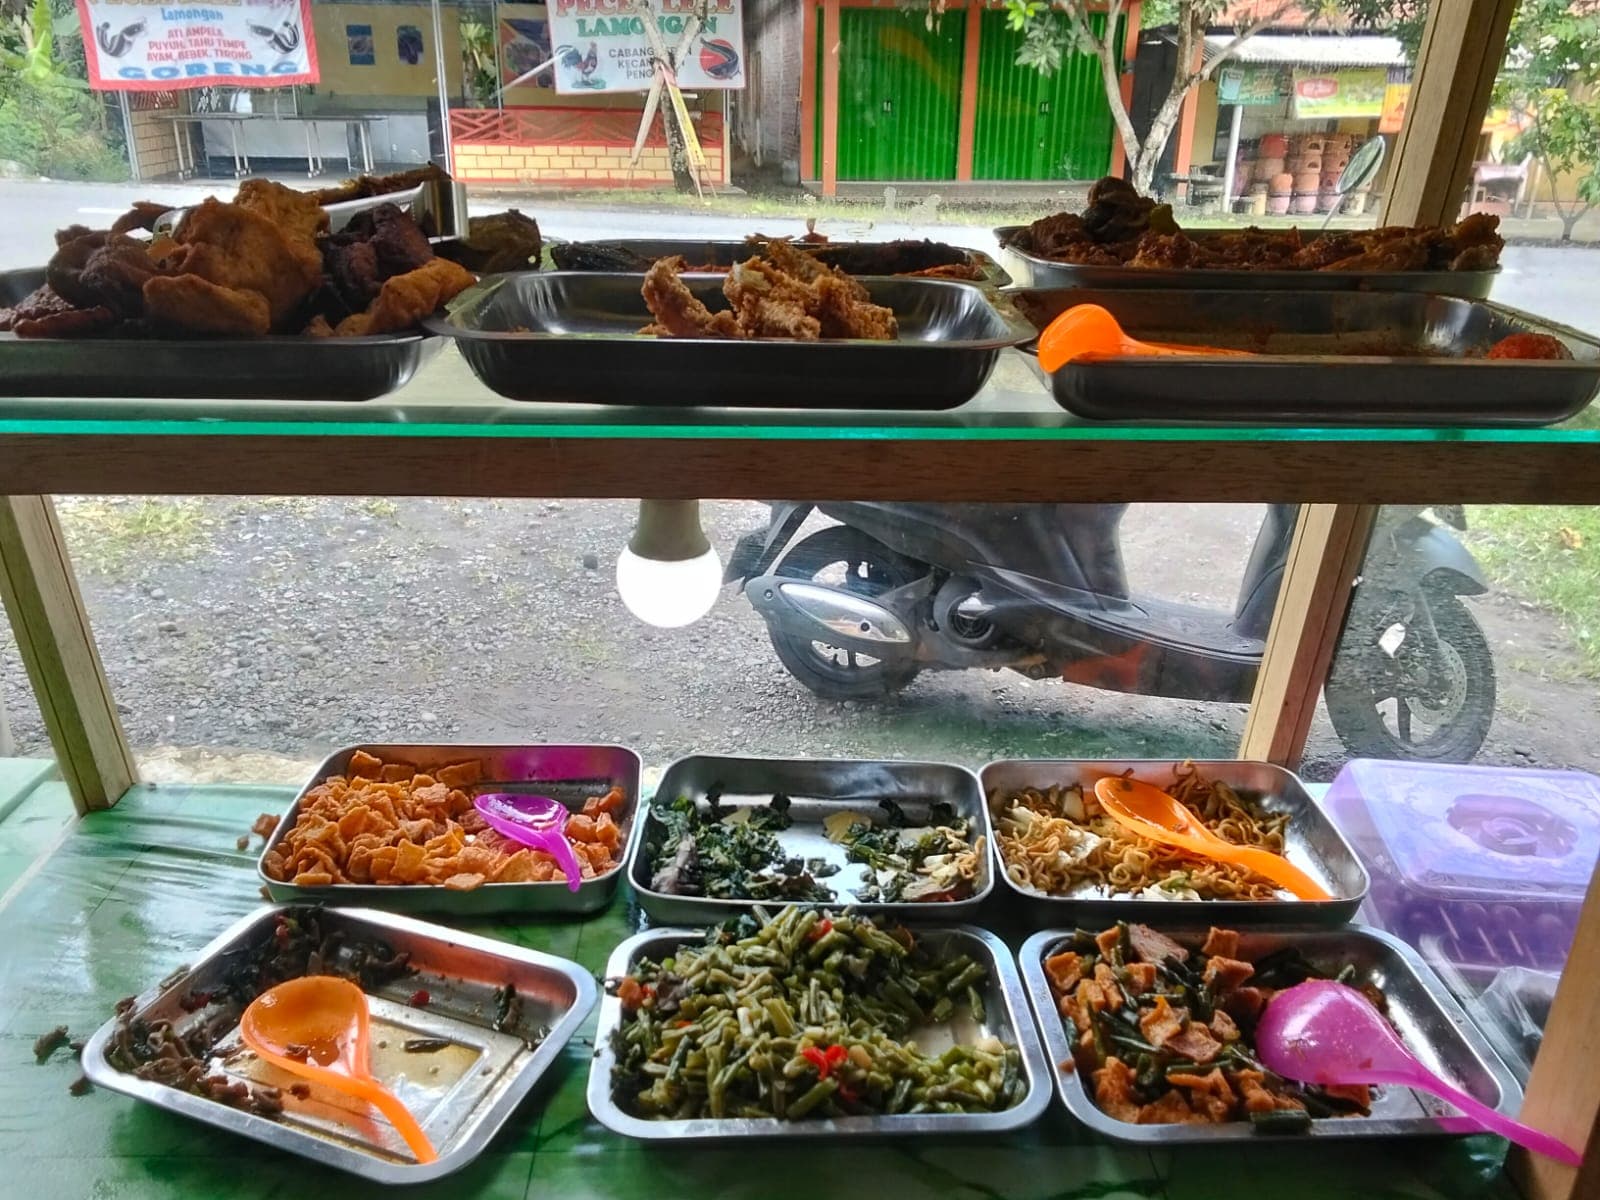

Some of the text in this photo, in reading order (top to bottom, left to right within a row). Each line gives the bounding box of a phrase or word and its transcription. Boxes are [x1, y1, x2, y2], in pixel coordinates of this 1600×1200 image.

[161, 7, 224, 21] Lamongan
[556, 0, 655, 17] PECE
[167, 27, 224, 39] ATI AMPELA
[577, 16, 717, 37] LAMOGN
[188, 37, 214, 48] TAHU
[217, 39, 246, 50] TEMPE
[608, 47, 655, 58] CABANG
[119, 62, 298, 79] GORENG
